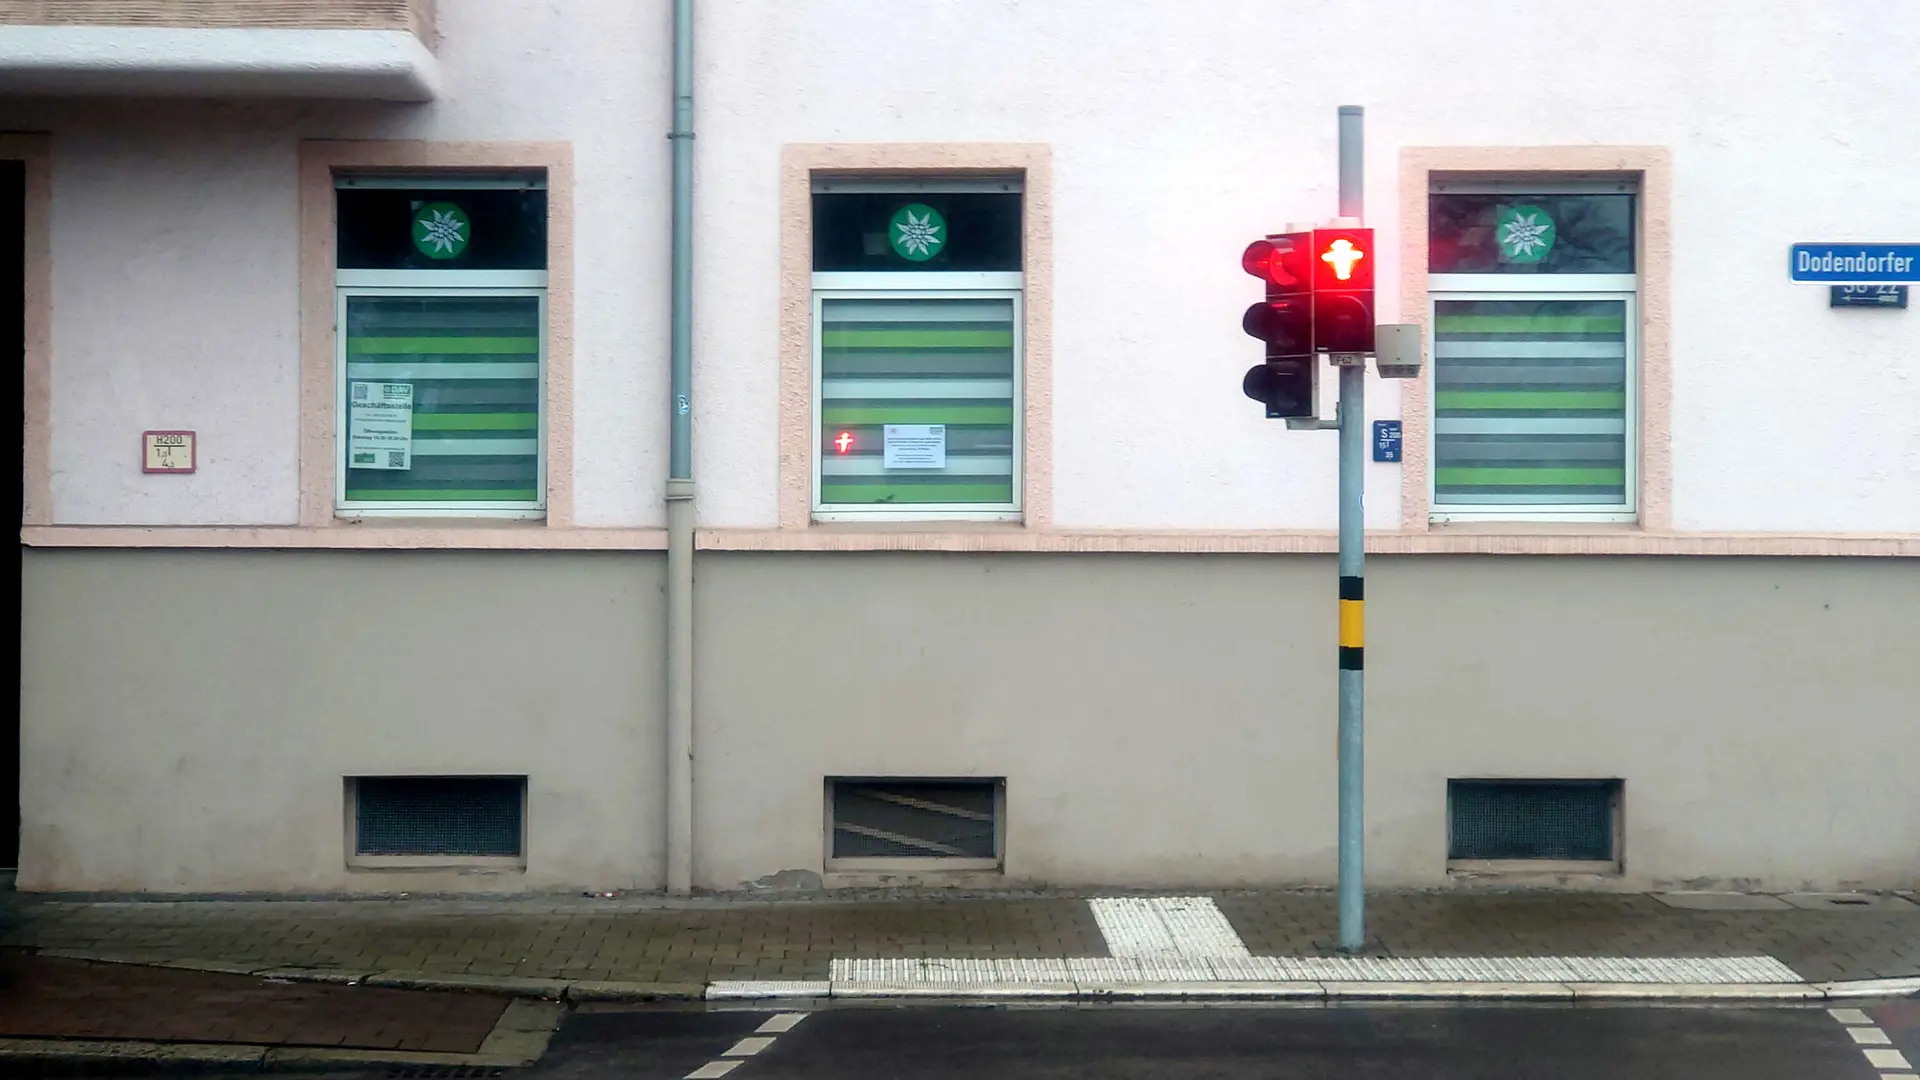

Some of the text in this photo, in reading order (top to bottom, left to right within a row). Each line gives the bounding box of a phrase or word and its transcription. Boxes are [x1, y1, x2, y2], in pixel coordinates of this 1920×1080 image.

[1798, 251, 1914, 273] Dodendorfer
[1336, 356, 1353, 364] F62
[1381, 428, 1388, 438] S
[156, 435, 183, 444] H200
